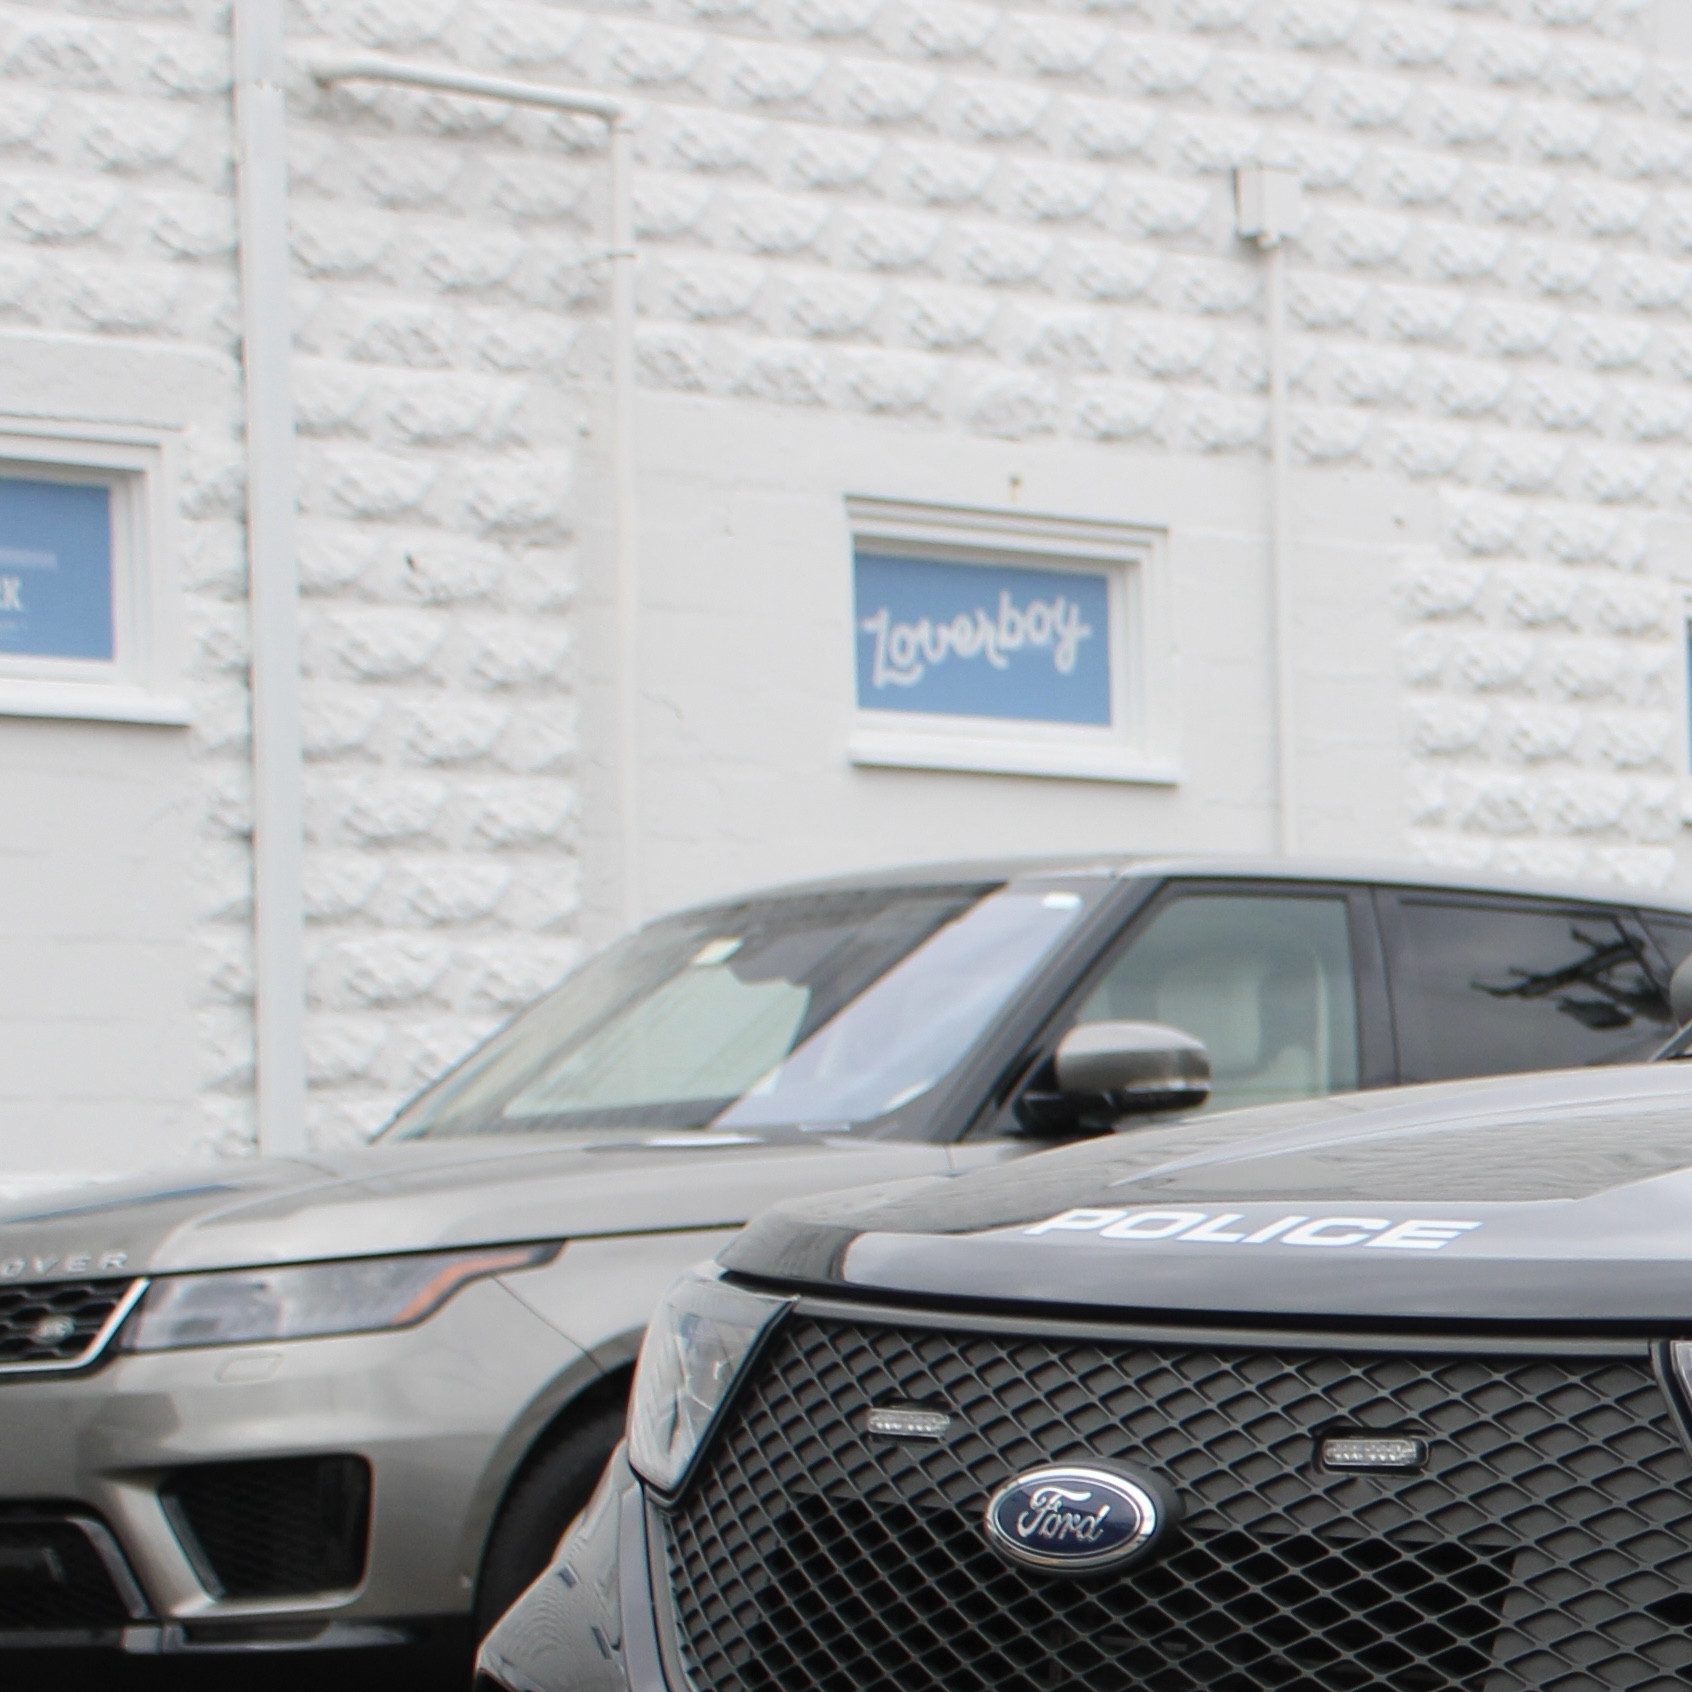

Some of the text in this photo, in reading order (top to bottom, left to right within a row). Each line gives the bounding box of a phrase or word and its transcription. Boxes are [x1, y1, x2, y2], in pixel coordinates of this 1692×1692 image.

[861, 588, 1092, 689] Loverboy
[1023, 1208, 1484, 1250] POLICE
[1017, 1486, 1112, 1543] Ford
